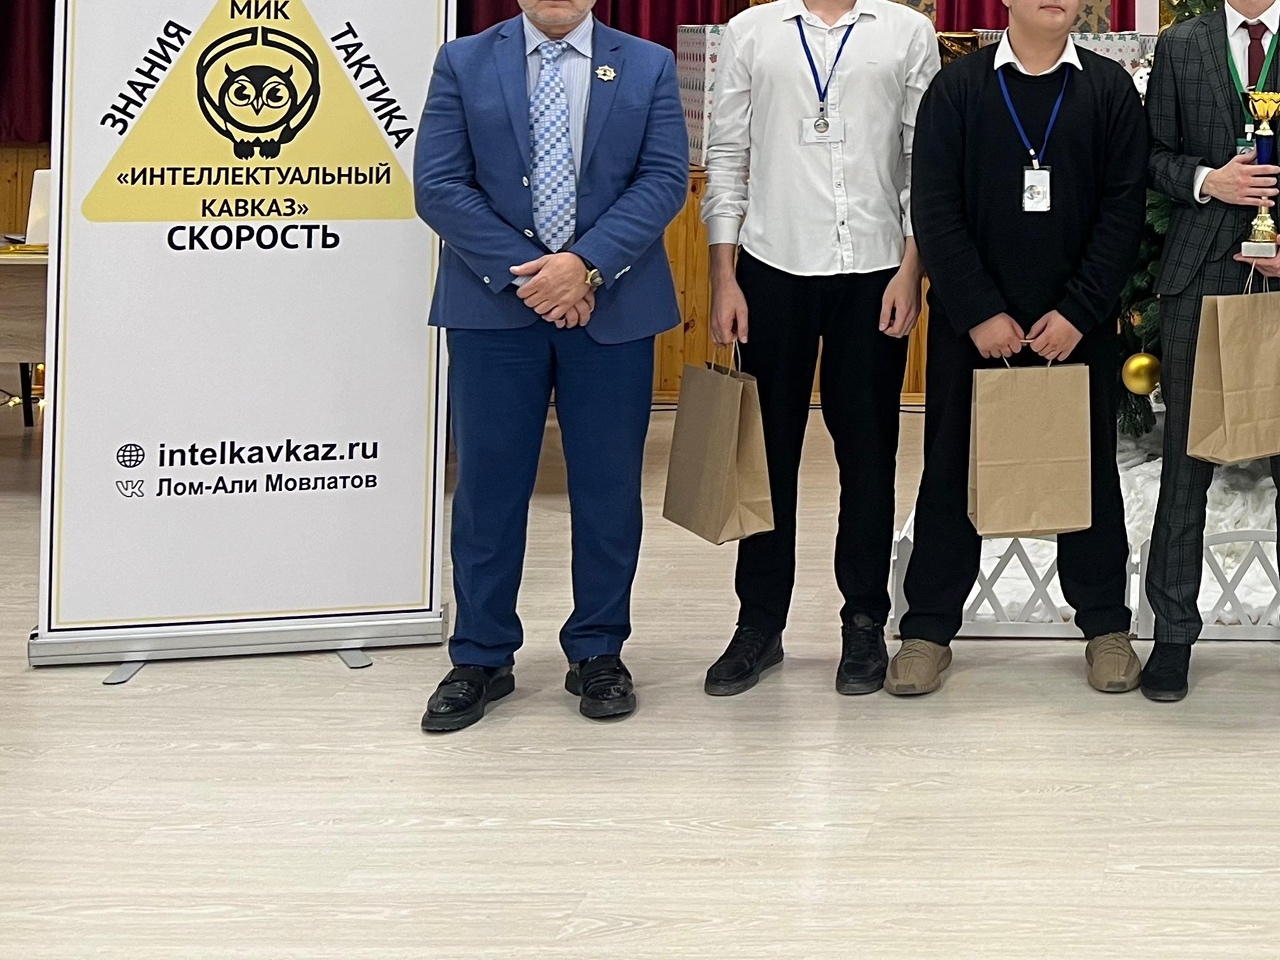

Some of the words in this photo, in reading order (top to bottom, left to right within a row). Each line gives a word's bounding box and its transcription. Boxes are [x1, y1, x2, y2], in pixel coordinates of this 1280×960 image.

[230, 0, 290, 20] МИК
[100, 20, 192, 136] ЗНАНИЯ
[331, 22, 415, 149] ТАКТИКА
[116, 163, 391, 185] «ИНТЕЛЛЕКТУАЛЬНЫЙ
[201, 198, 309, 218] КАВКАЗ»
[167, 224, 340, 251] СКОРОСТЬ
[159, 439, 379, 467] intelkavkaz.ru
[156, 476, 258, 497] Лом-Али
[265, 473, 378, 492] Мовлатов
